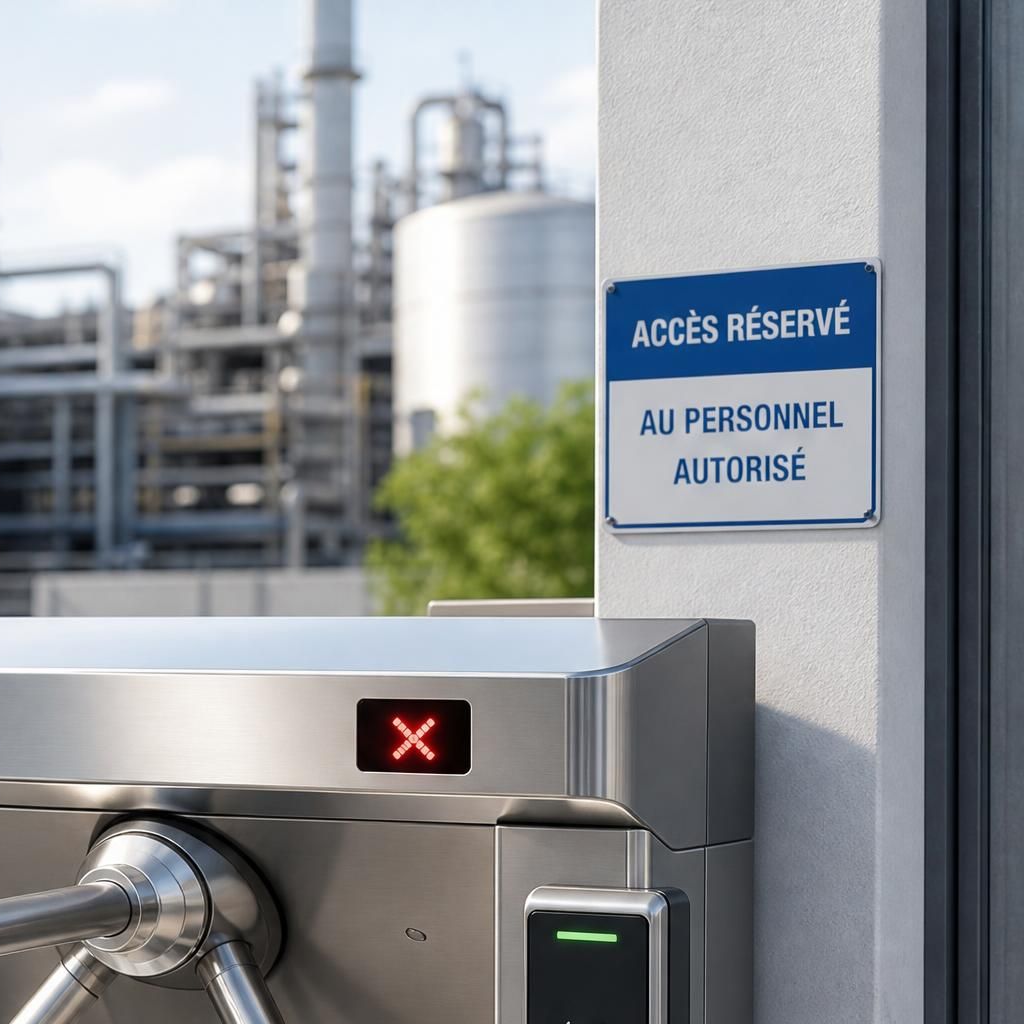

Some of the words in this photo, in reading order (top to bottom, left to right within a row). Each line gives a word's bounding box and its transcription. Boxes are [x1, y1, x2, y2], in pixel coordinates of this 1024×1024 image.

[632, 309, 719, 348] ACCÈS
[727, 299, 850, 342] RÉSERVÉ
[640, 409, 674, 436] AU
[685, 401, 843, 434] PERSONNEL
[673, 446, 806, 485] AUTORISÉ
